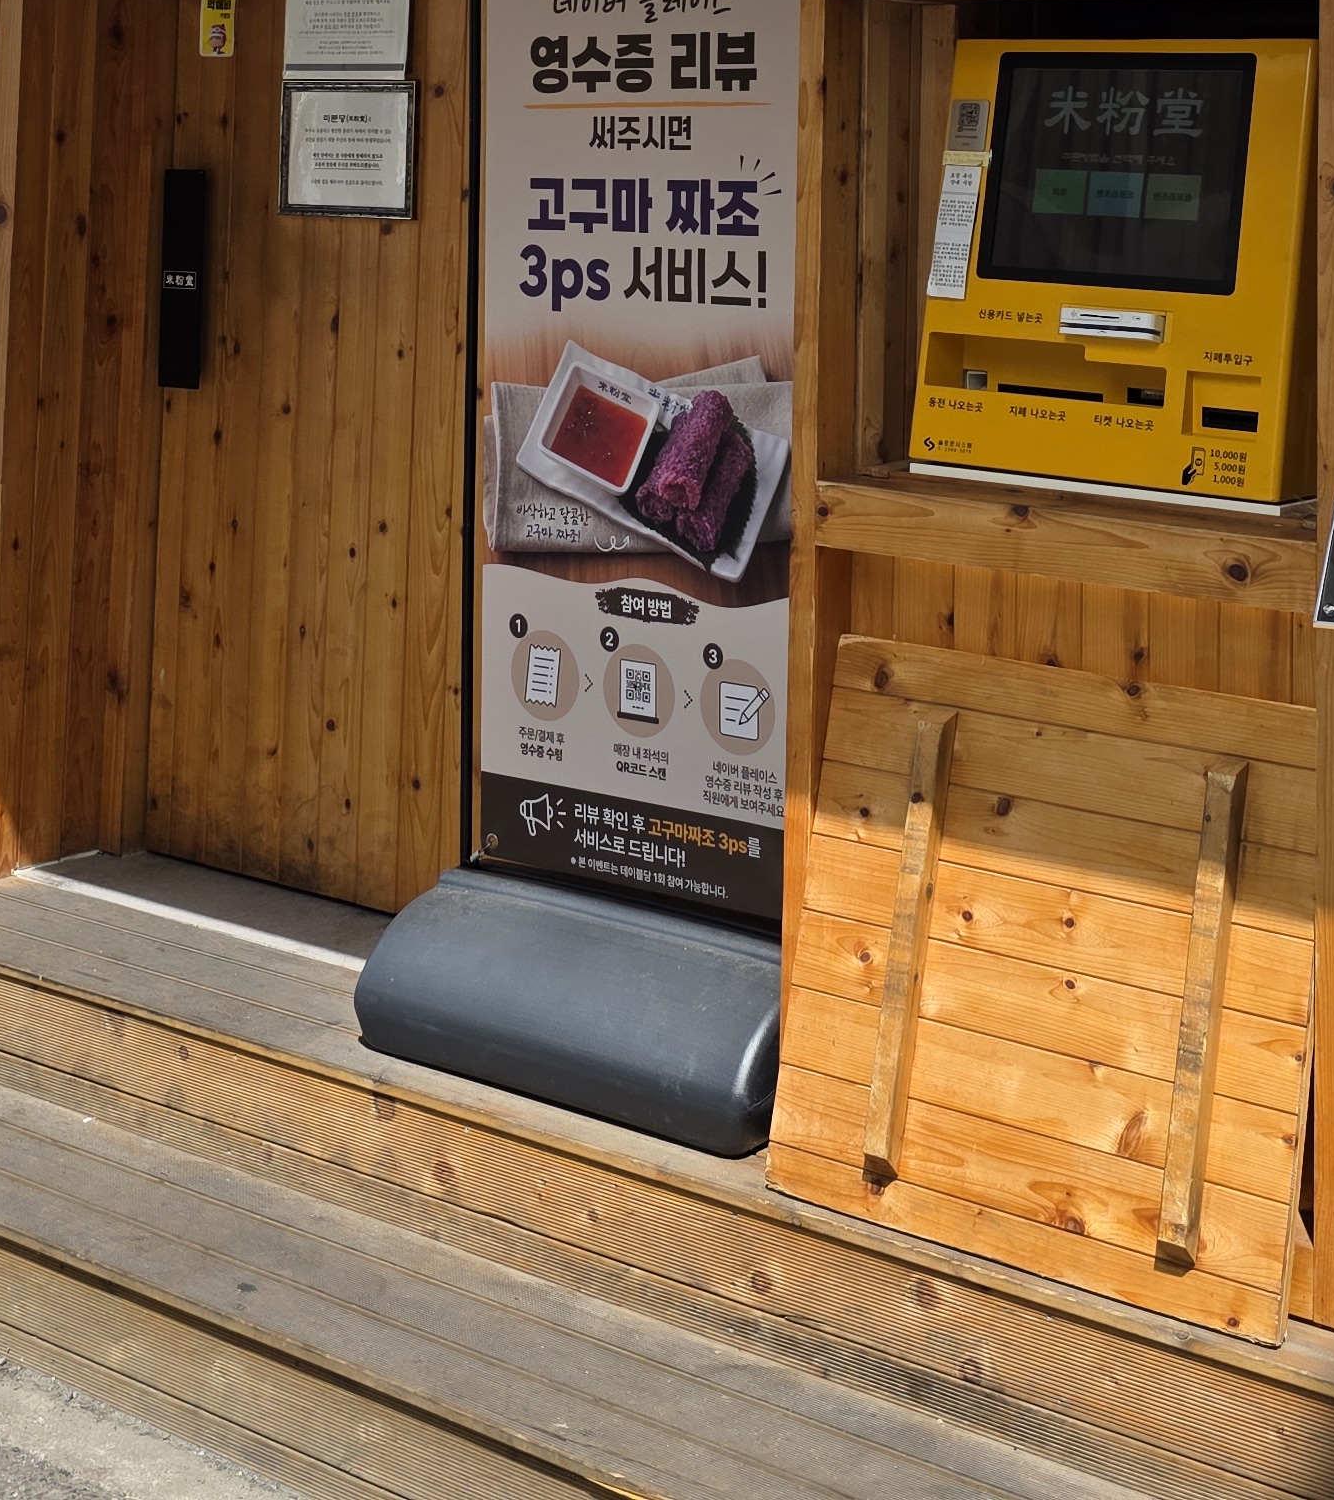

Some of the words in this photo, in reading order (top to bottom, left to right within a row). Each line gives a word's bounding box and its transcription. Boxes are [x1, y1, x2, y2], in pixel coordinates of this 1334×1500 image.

[530, 34, 654, 94] 영수증
[670, 31, 758, 92] 리뷰
[1044, 85, 1204, 138] 米粉堂
[589, 115, 692, 150] 써주시면
[528, 177, 653, 234] 고구마
[665, 179, 760, 237] 짜조
[519, 244, 611, 312] 3ps
[623, 246, 767, 309] 서비스!
[978, 308, 1013, 322] 신용카드
[1016, 311, 1043, 325] 넣는곳
[1203, 351, 1253, 366] 지폐투입구
[928, 396, 946, 409] 동전
[948, 398, 984, 413] 나오는곳
[1009, 405, 1028, 418] 지폐
[1030, 408, 1067, 423] 나오는곳
[1094, 414, 1113, 427] 티켓
[1116, 417, 1154, 431] 나오는곳
[1210, 449, 1247, 462] 10,000원
[1214, 462, 1246, 475] 5,000원
[1213, 474, 1245, 487] 1,000원
[517, 501, 556, 520] 바삭하고
[559, 504, 592, 527] 달콤한
[525, 523, 553, 539] 고구마
[555, 527, 582, 543] 짜조!
[620, 593, 645, 616] 참여
[647, 597, 673, 619] 방법
[515, 618, 522, 633] 1
[605, 632, 614, 647] 2
[707, 649, 719, 664] 3
[519, 726, 555, 745] 주문/결제
[556, 732, 565, 746] 후
[520, 742, 545, 759] 영수증
[613, 743, 630, 758] 매장
[632, 746, 641, 760] 내
[642, 748, 669, 765] 좌석의
[616, 760, 647, 777] QR코드
[648, 766, 667, 781] 스캔
[713, 760, 739, 778] 네이버
[741, 765, 778, 785] 플레이스
[705, 774, 732, 792] 영수증
[733, 781, 752, 796] 리뷰
[753, 784, 772, 800] 작성
[773, 788, 784, 802] 후
[703, 789, 739, 810] 직원에게
[739, 798, 785, 818] 보여주세요
[574, 803, 600, 826] 리뷰
[602, 807, 629, 832] 확인
[632, 813, 646, 835] 후
[648, 817, 716, 848] 고구마짜조
[718, 833, 762, 859] 3ps를
[573, 827, 626, 856] 서비스로
[628, 839, 686, 869] 드립니다!
[578, 856, 586, 868] 본
[587, 858, 619, 876] 이벤트는
[619, 865, 651, 883] 테이블당
[653, 872, 666, 886] 1회
[667, 875, 684, 890] 참여
[685, 879, 729, 899] 가능합니다.
